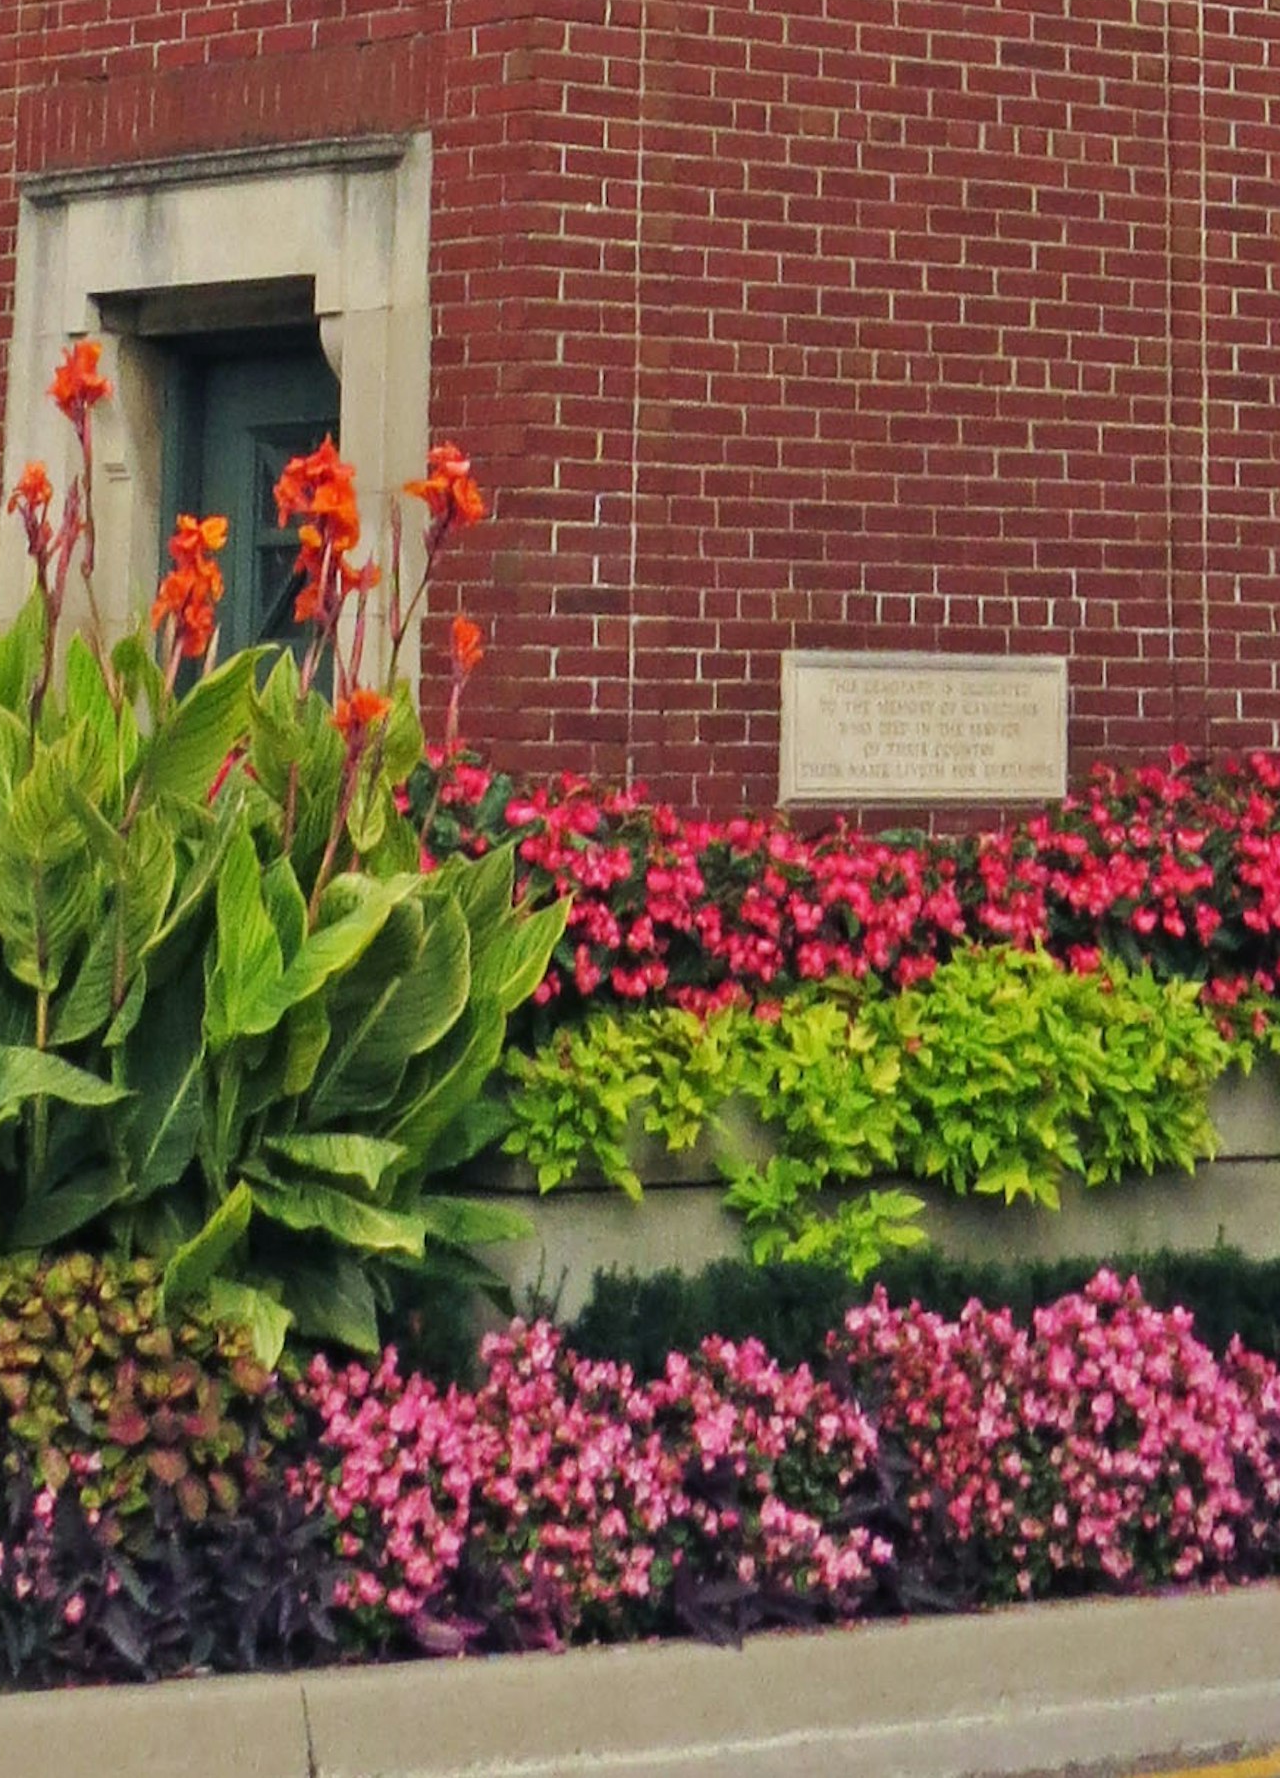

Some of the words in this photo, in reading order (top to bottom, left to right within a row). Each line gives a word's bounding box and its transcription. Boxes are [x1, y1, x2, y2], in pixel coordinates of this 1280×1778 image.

[845, 700, 871, 715] THE
[877, 700, 934, 715] MEMORY
[916, 721, 930, 736] IN
[936, 722, 964, 737] THE
